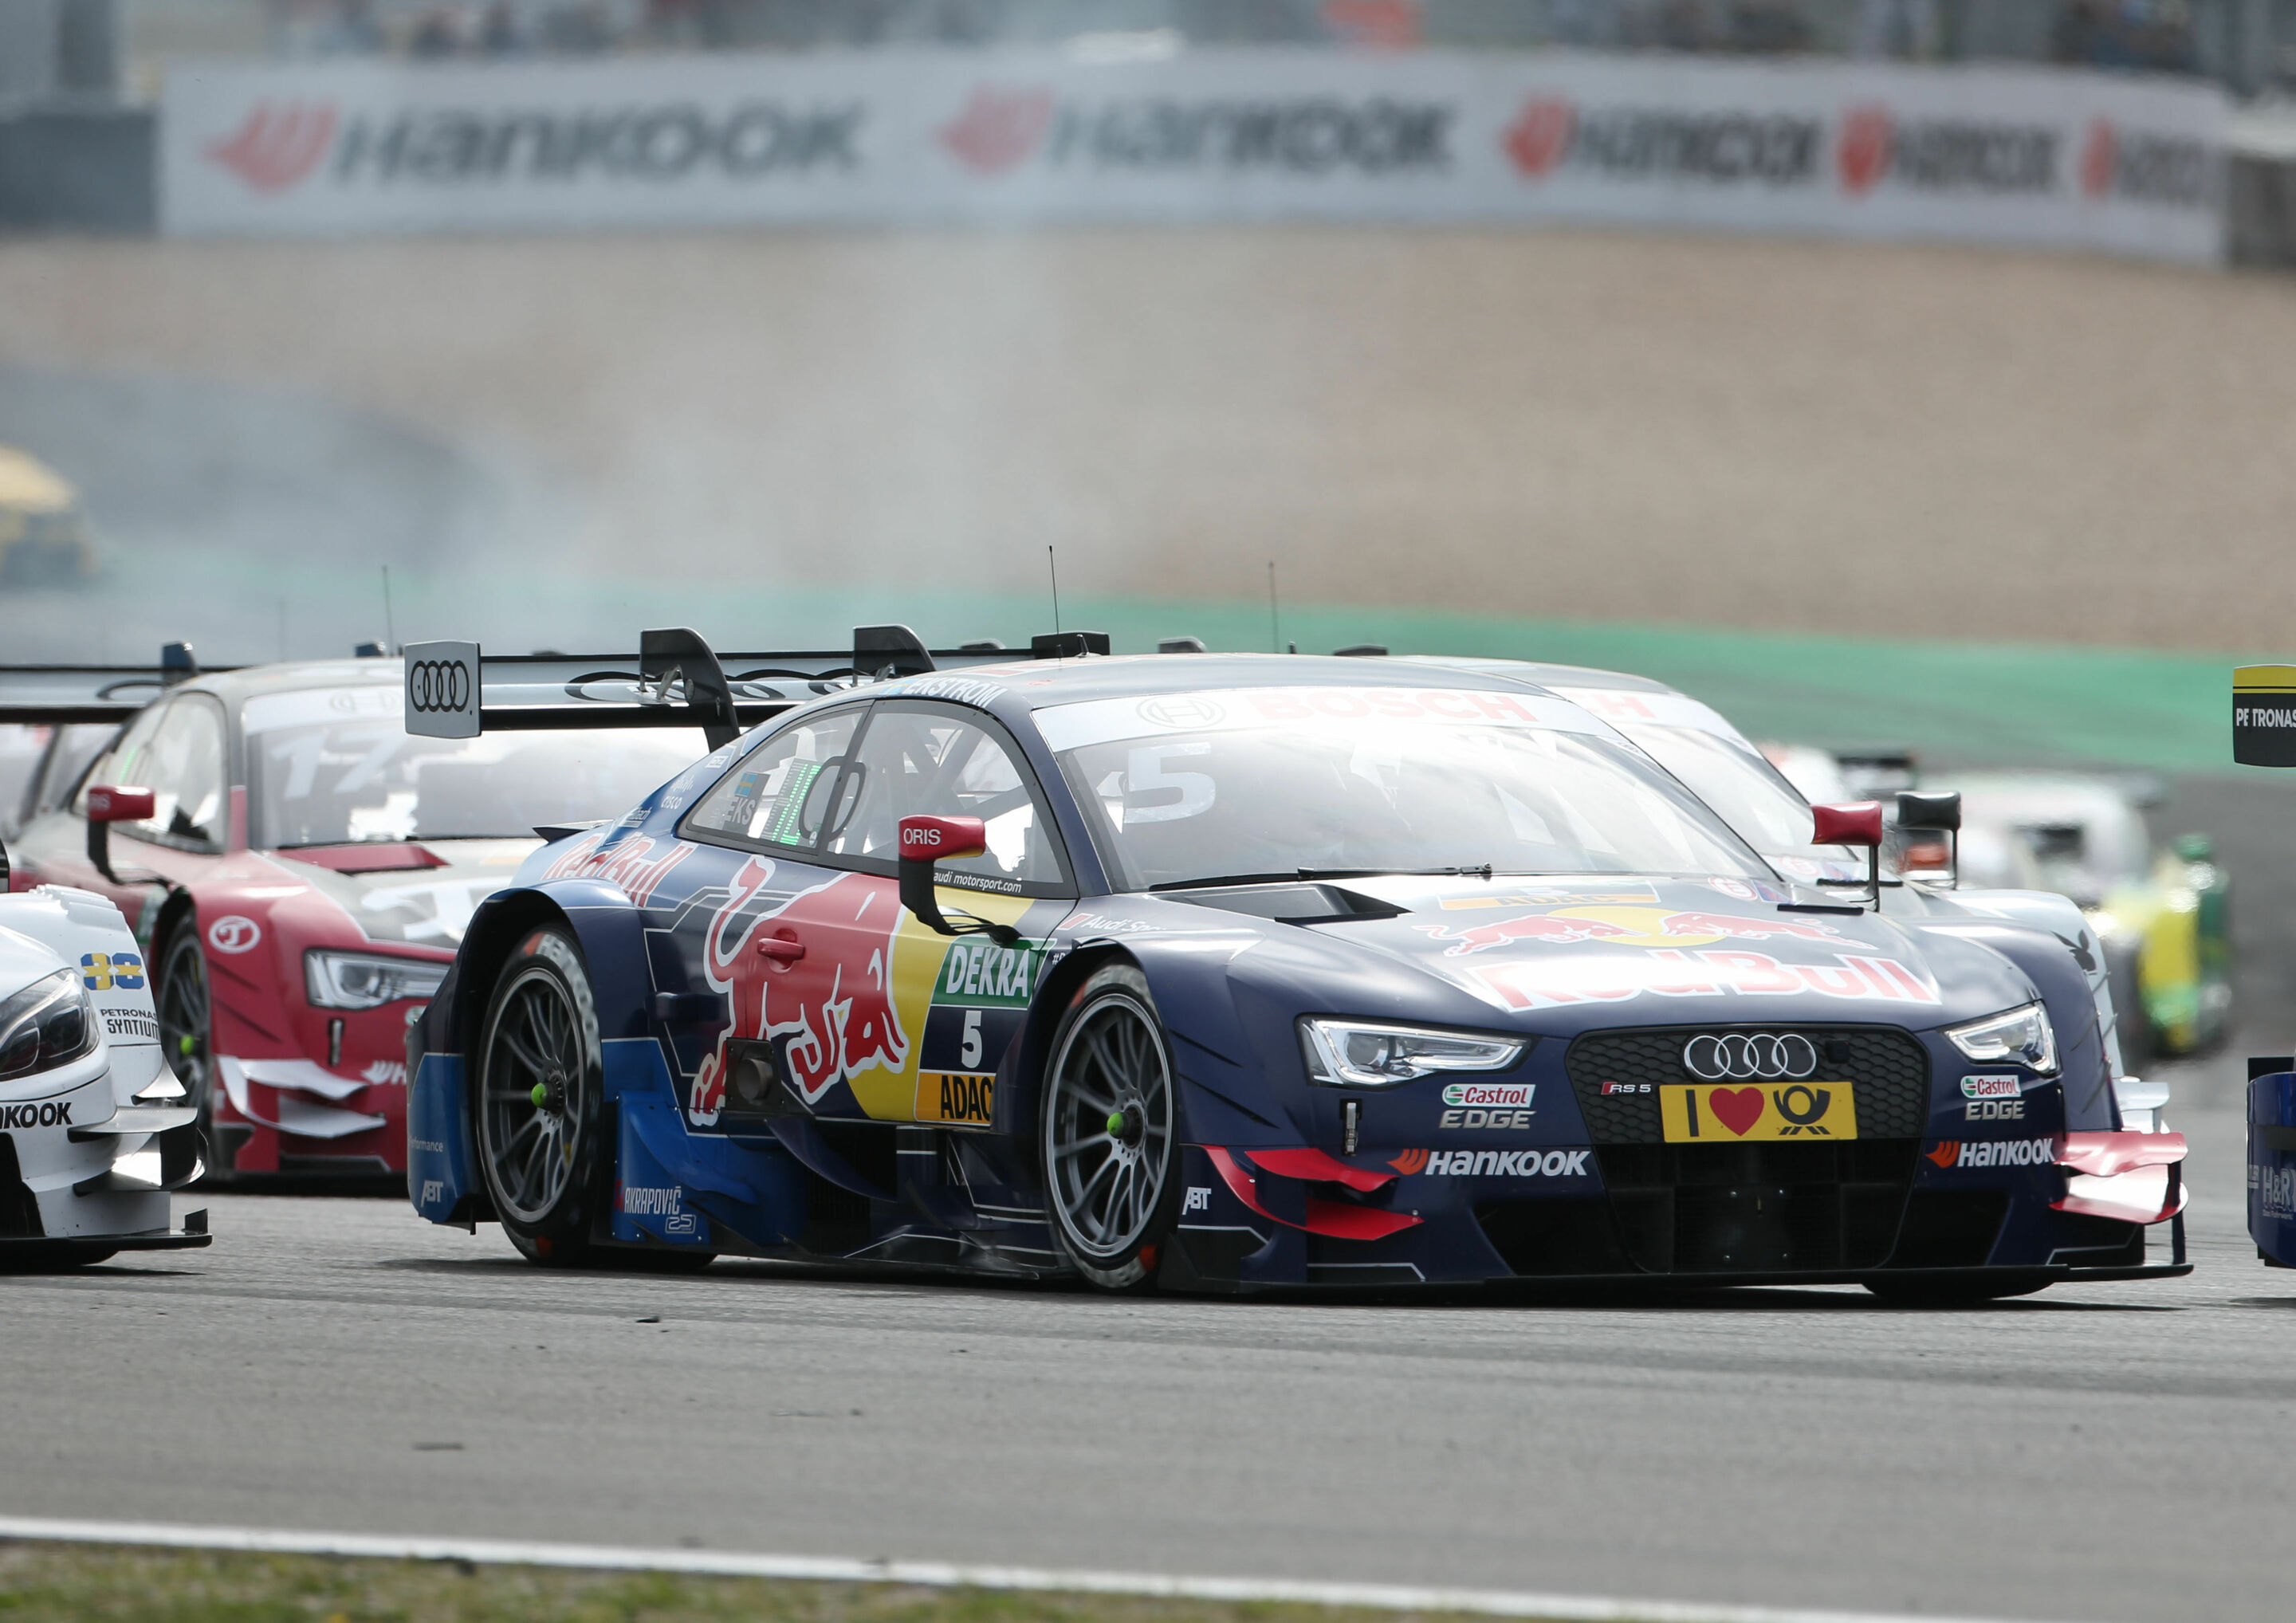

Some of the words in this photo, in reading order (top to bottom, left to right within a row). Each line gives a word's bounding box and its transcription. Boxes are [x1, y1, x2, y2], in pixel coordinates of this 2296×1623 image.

[1246, 691, 1539, 722] BOSCH
[1124, 742, 1216, 823] 5
[903, 828, 942, 845] ORIS
[946, 945, 1029, 997] DEKRA
[961, 1010, 982, 1069] 5
[941, 1075, 992, 1121] ADAC
[1464, 1087, 1527, 1104] Castrol
[1608, 1083, 1635, 1094] RS
[1639, 1084, 1651, 1093] 5
[1977, 1078, 2019, 1095] Castrol
[1439, 1110, 1537, 1130] EDGE
[1685, 1089, 1700, 1138] I
[1965, 1100, 2026, 1121] EDGE
[420, 1180, 444, 1208] ABT
[1181, 1186, 1212, 1215] ABT
